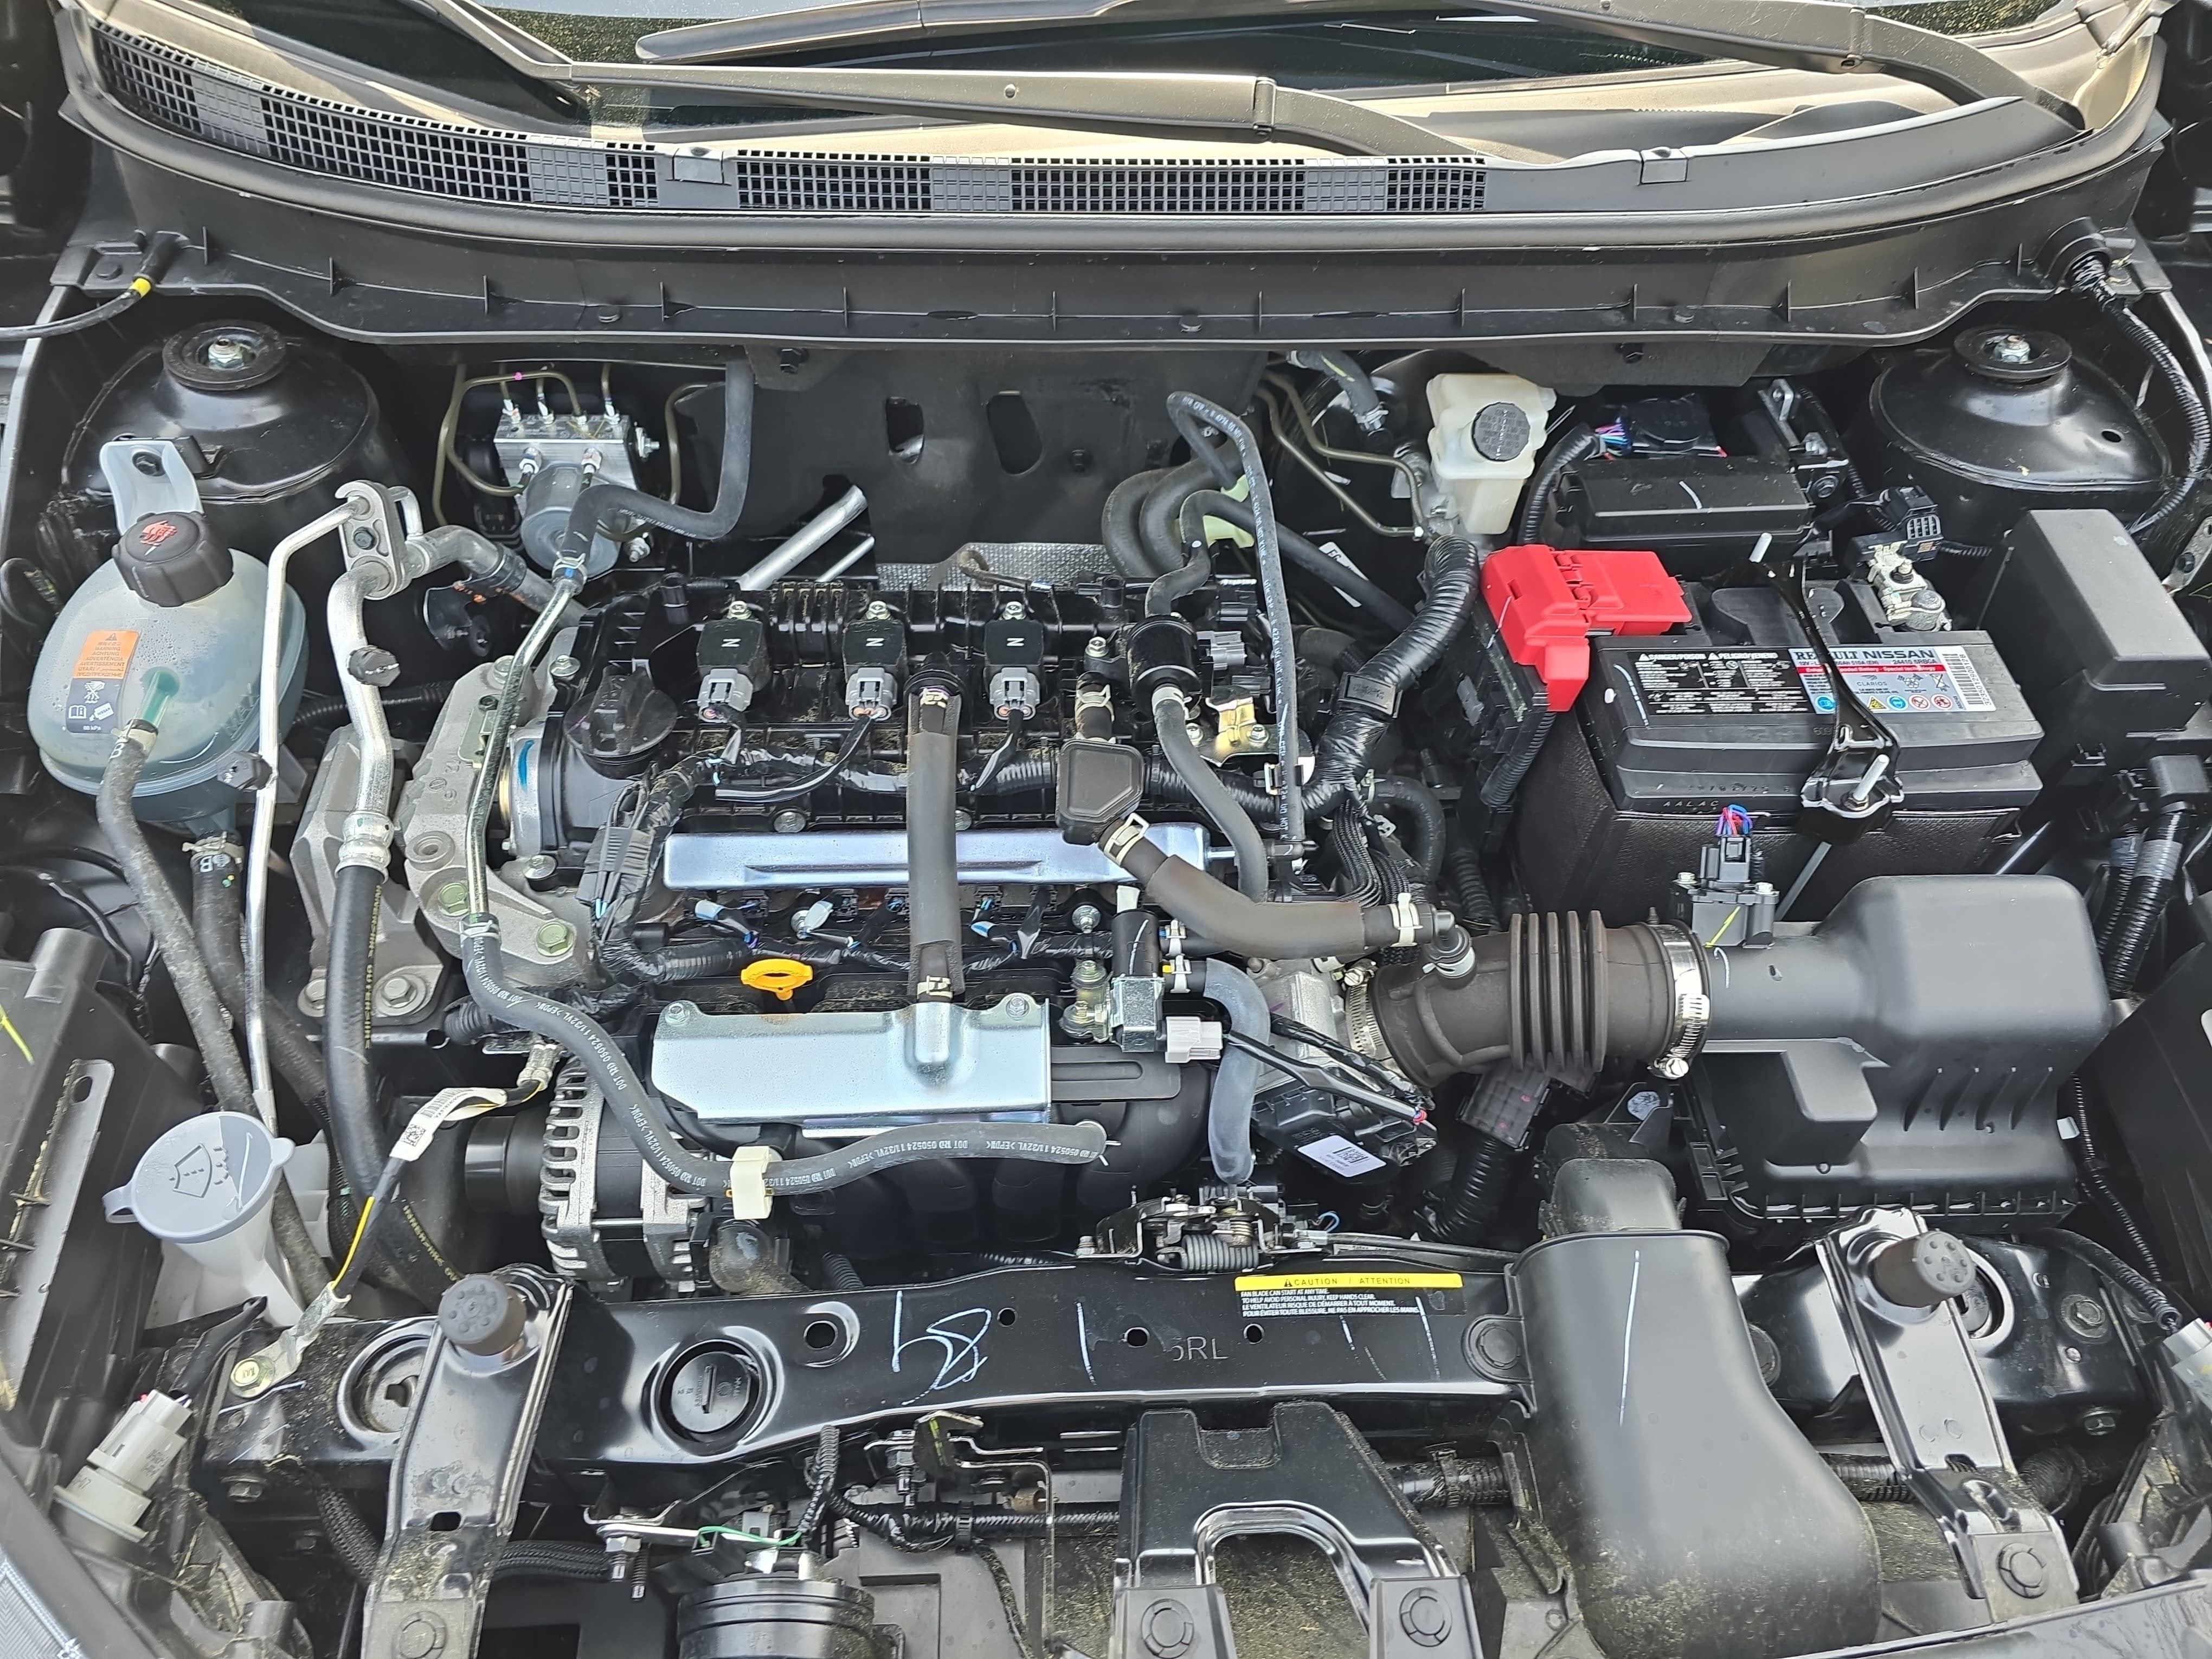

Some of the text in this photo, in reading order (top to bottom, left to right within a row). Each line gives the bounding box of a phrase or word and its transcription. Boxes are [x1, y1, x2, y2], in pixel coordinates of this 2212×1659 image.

[1793, 650, 1935, 660] REULT NISSAN
[97, 706, 111, 716] NISSAN
[1280, 818, 1289, 831] NOT
[481, 976, 501, 994] 050524
[587, 1033, 612, 1064] 050524
[613, 1075, 627, 1091] DOT
[906, 1140, 937, 1150] 050524
[954, 1140, 968, 1149] DOT
[1050, 1145, 1079, 1156] 050524
[660, 1154, 682, 1178] 050524
[822, 1168, 837, 1180] DOT
[691, 1176, 707, 1186] DOT
[786, 1174, 812, 1186] 050524
[1294, 1277, 1338, 1286] CAUTION
[1317, 1299, 1348, 1307] DÉMARRER
